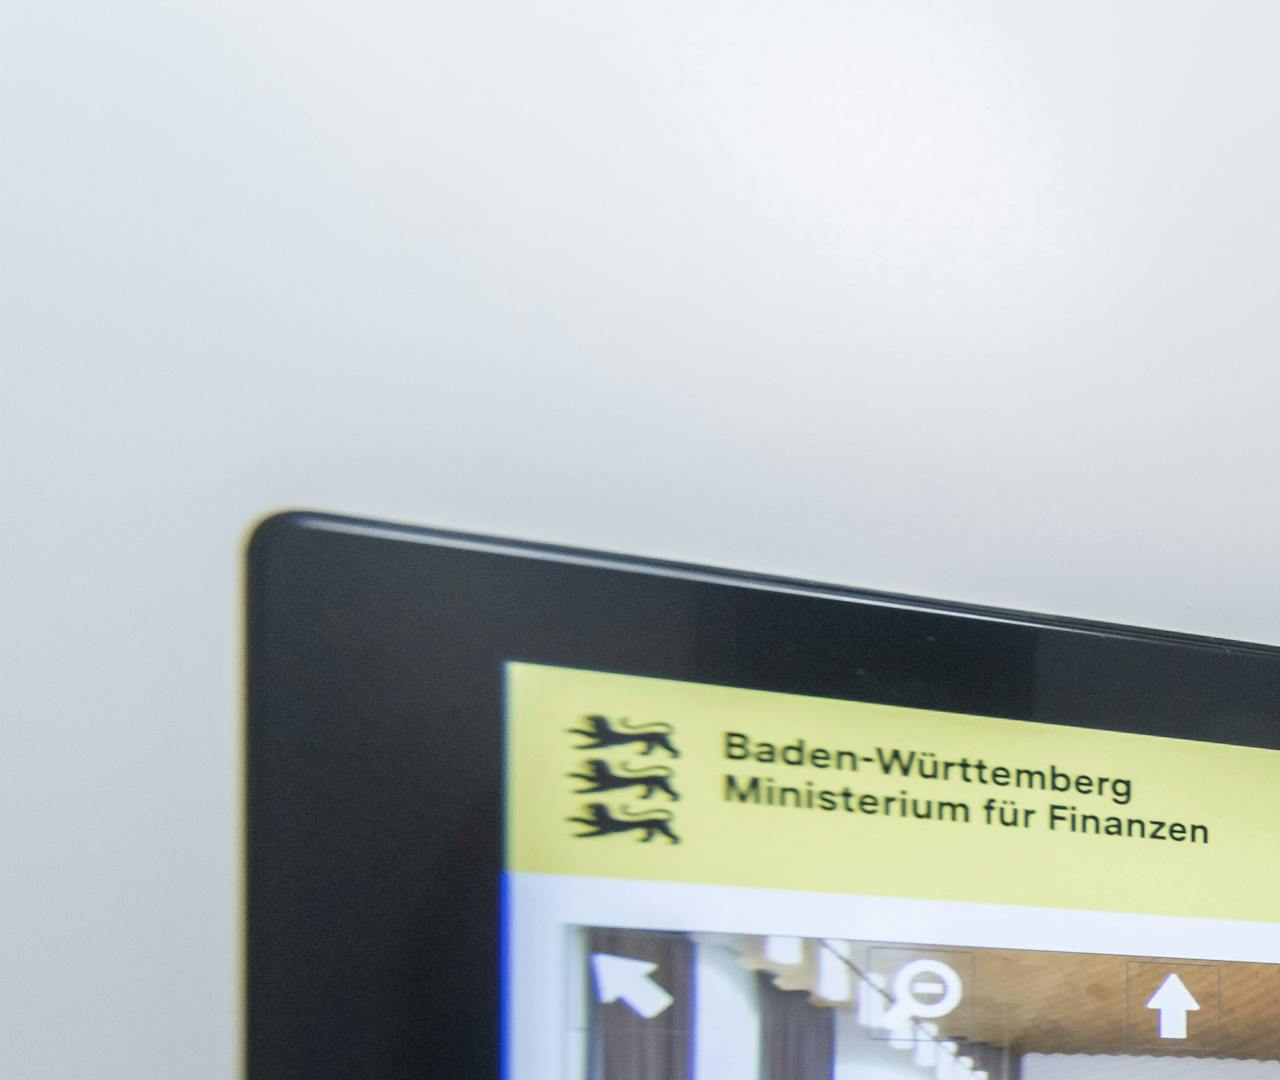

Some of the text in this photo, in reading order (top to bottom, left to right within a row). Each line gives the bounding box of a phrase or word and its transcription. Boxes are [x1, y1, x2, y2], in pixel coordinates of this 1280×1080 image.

[724, 732, 1132, 804] Baden-Württemberg
[724, 775, 1210, 844] Ministerium für Finanzen
